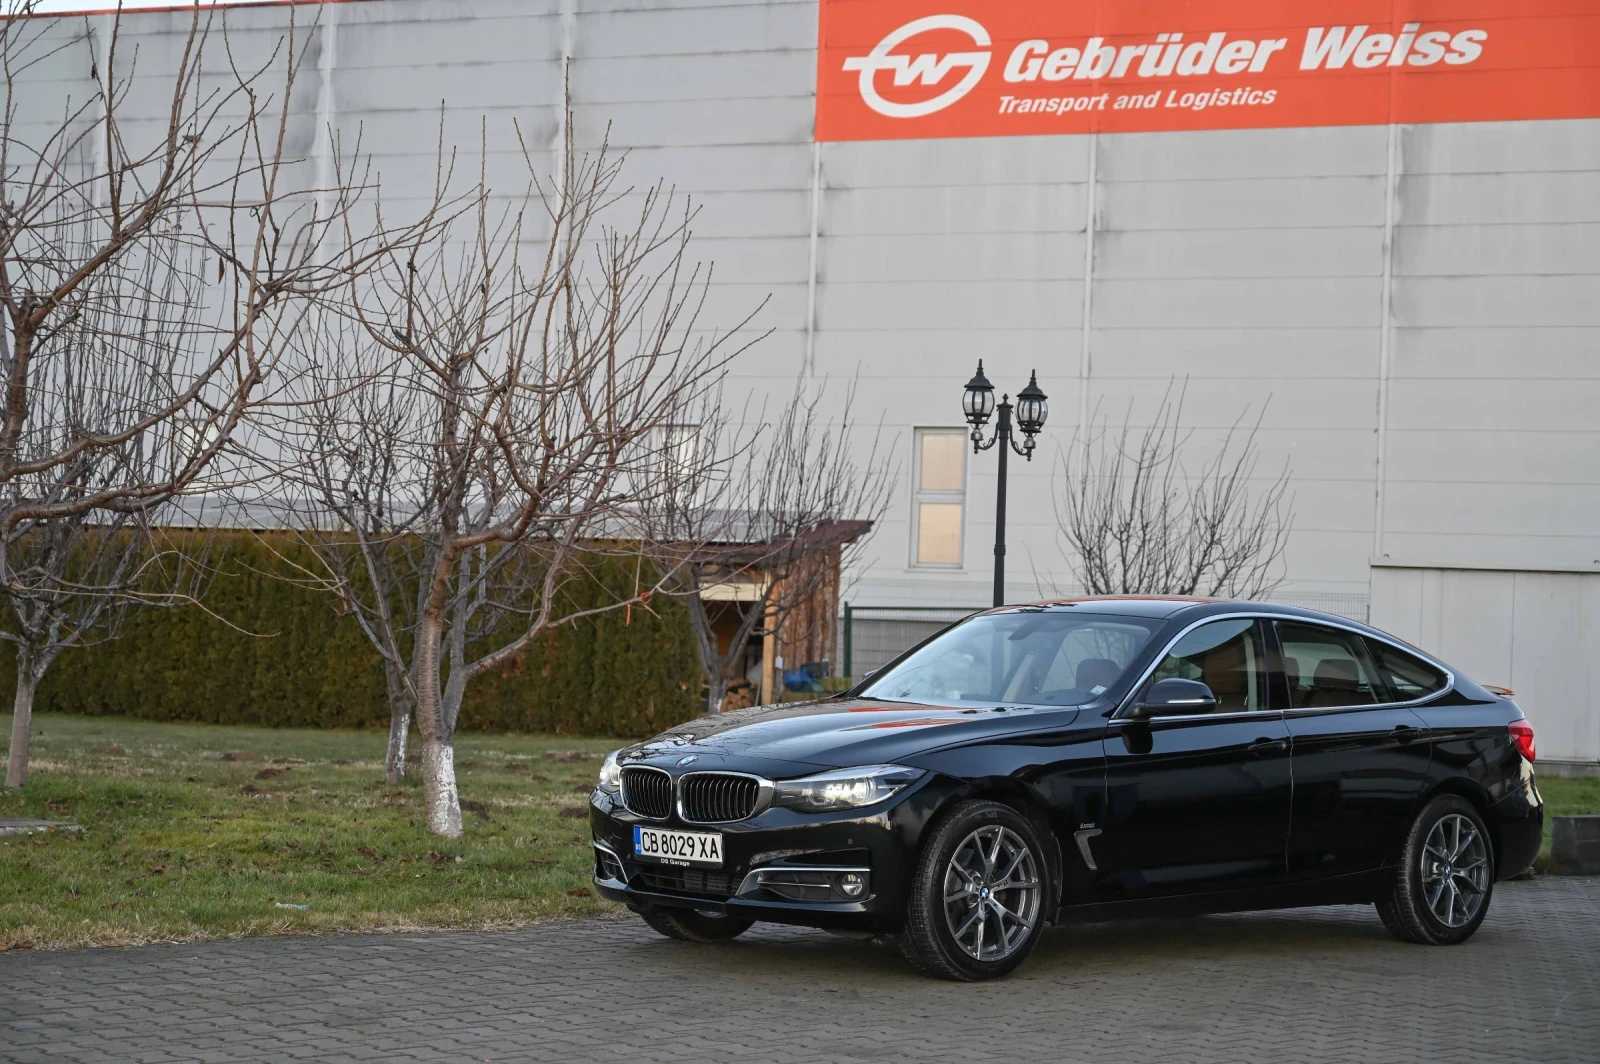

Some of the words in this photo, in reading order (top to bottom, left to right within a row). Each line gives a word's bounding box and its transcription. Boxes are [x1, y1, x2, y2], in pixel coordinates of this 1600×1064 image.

[1003, 31, 1287, 83] Gebrüder
[1299, 22, 1488, 71] Weiss
[998, 92, 1109, 115] Transport
[1113, 90, 1162, 110] and
[1165, 86, 1277, 111] Logistics
[642, 831, 659, 853] CB
[661, 833, 695, 857] 8029
[698, 836, 720, 859] XA
[670, 858, 690, 867] Garage
